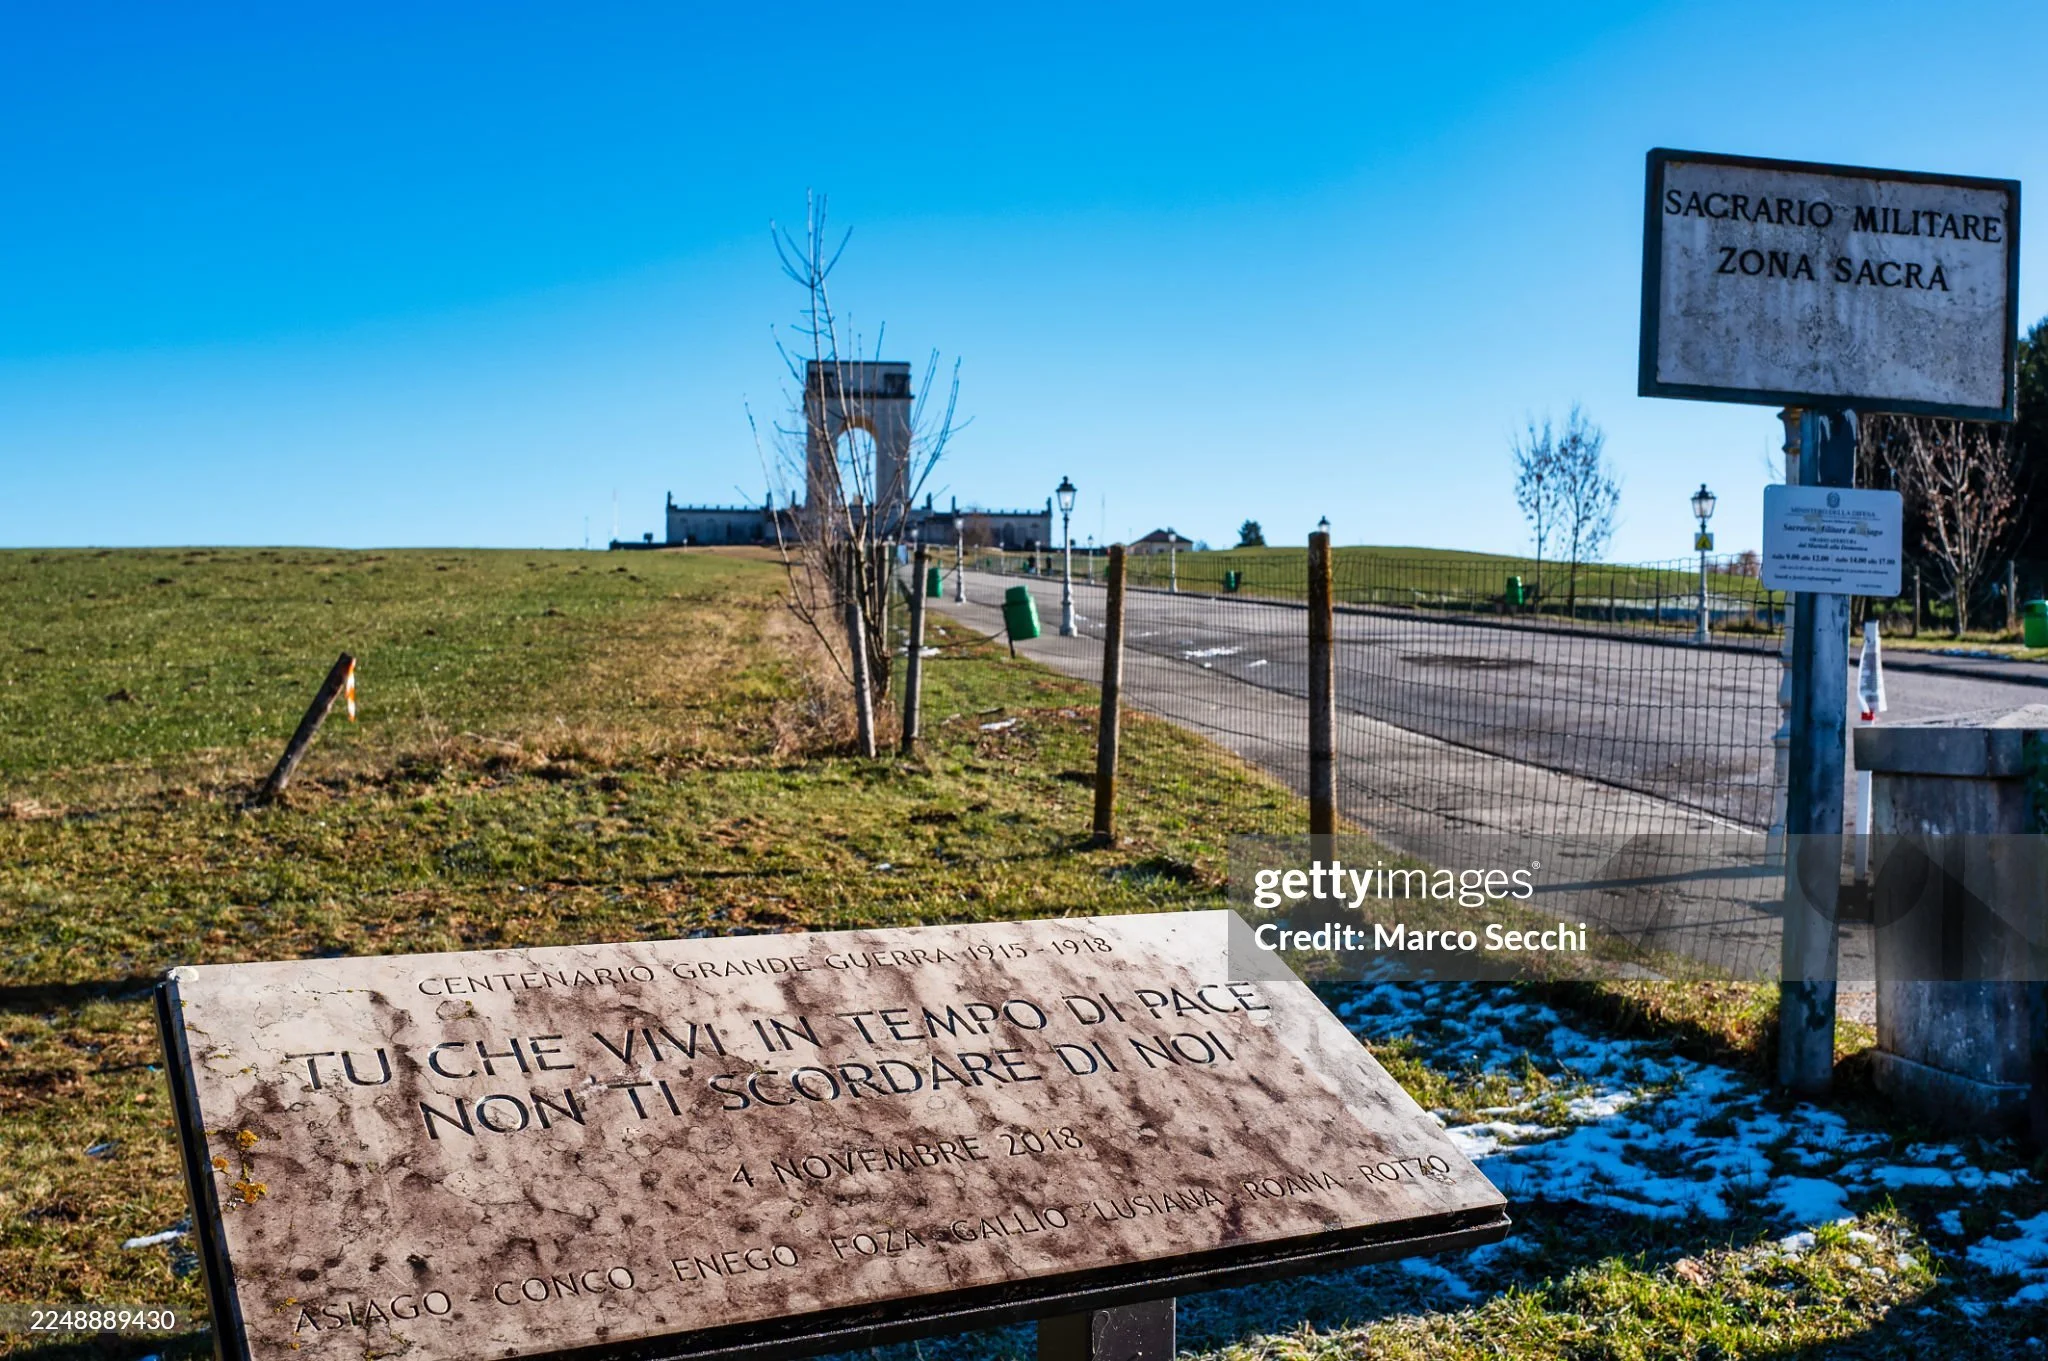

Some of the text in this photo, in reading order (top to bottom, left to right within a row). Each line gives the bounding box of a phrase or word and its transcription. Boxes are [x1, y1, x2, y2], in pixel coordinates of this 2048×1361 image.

[1665, 189, 2002, 243] SACRARIO MILITARE
[1717, 246, 1950, 292] ZONA SACRA
[418, 964, 655, 997] CENTENARIO
[672, 956, 812, 980] GRANDE
[825, 947, 954, 970] GUERRA
[968, 941, 1029, 962] 1915
[1051, 936, 1113, 957] 1918
[284, 982, 1271, 1090] TU CHE VIVI IN TEMPO DI PACE
[419, 1031, 1235, 1140] NON TI SCORDARE DI NOI
[731, 1126, 1084, 1188] 4 NOVEMBRE 2018
[294, 1290, 451, 1334] ASIAGO
[493, 1266, 636, 1306] CONCO
[670, 1245, 799, 1282] ENEGO
[830, 1228, 926, 1259] FOZA
[952, 1207, 1068, 1242] GALLIO
[1093, 1188, 1224, 1222] LUSIANA
[1243, 1170, 1344, 1201] ROANA
[1359, 1154, 1451, 1184] ROTZO
